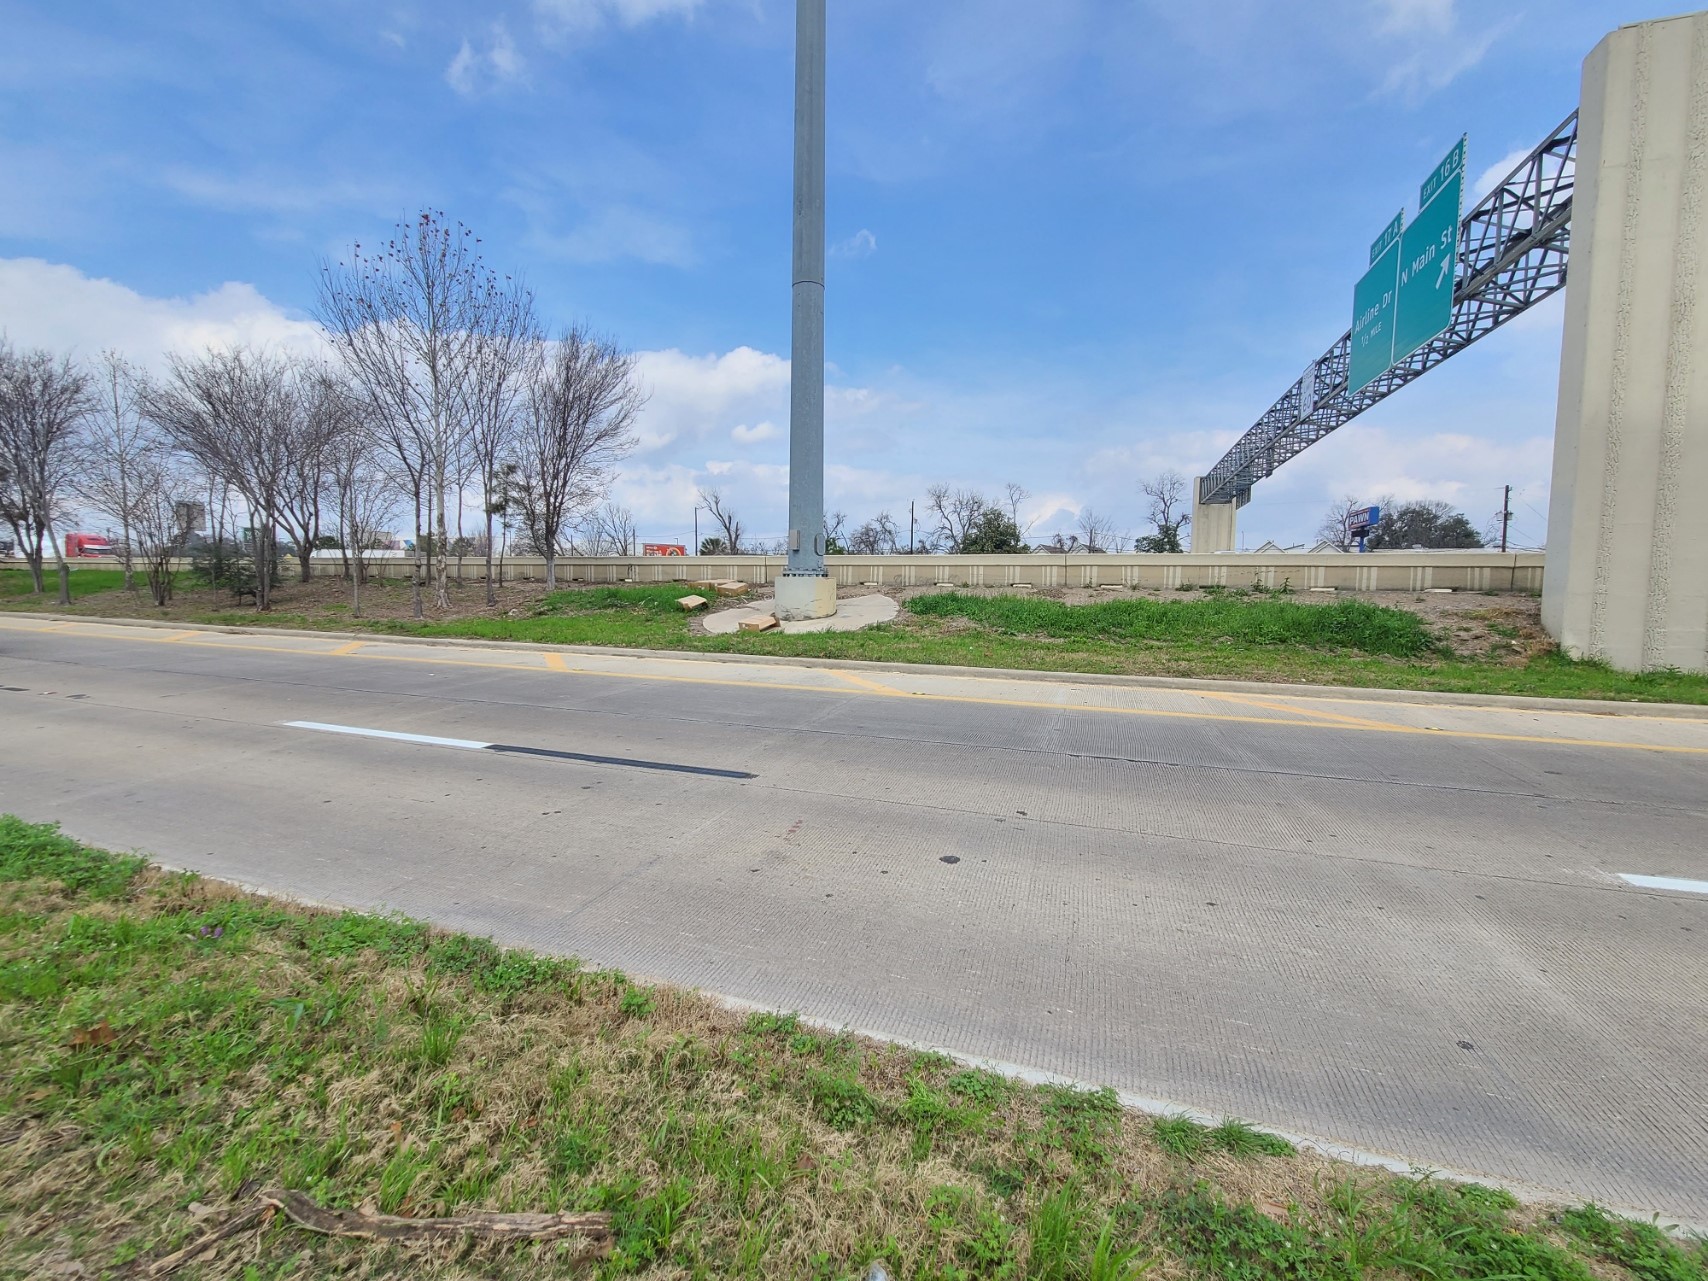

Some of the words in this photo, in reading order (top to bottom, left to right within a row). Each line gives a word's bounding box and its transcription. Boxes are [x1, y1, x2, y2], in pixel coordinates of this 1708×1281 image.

[1423, 176, 1437, 199] EXIT
[1440, 159, 1450, 181] 16
[1452, 149, 1459, 168] B
[1401, 268, 1408, 287] N
[1411, 244, 1435, 278] Main
[1440, 224, 1453, 250] St
[1354, 303, 1380, 335] Airline
[1382, 290, 1392, 309] Dr
[1370, 321, 1382, 338] MILE
[1350, 512, 1370, 525] PAWN
